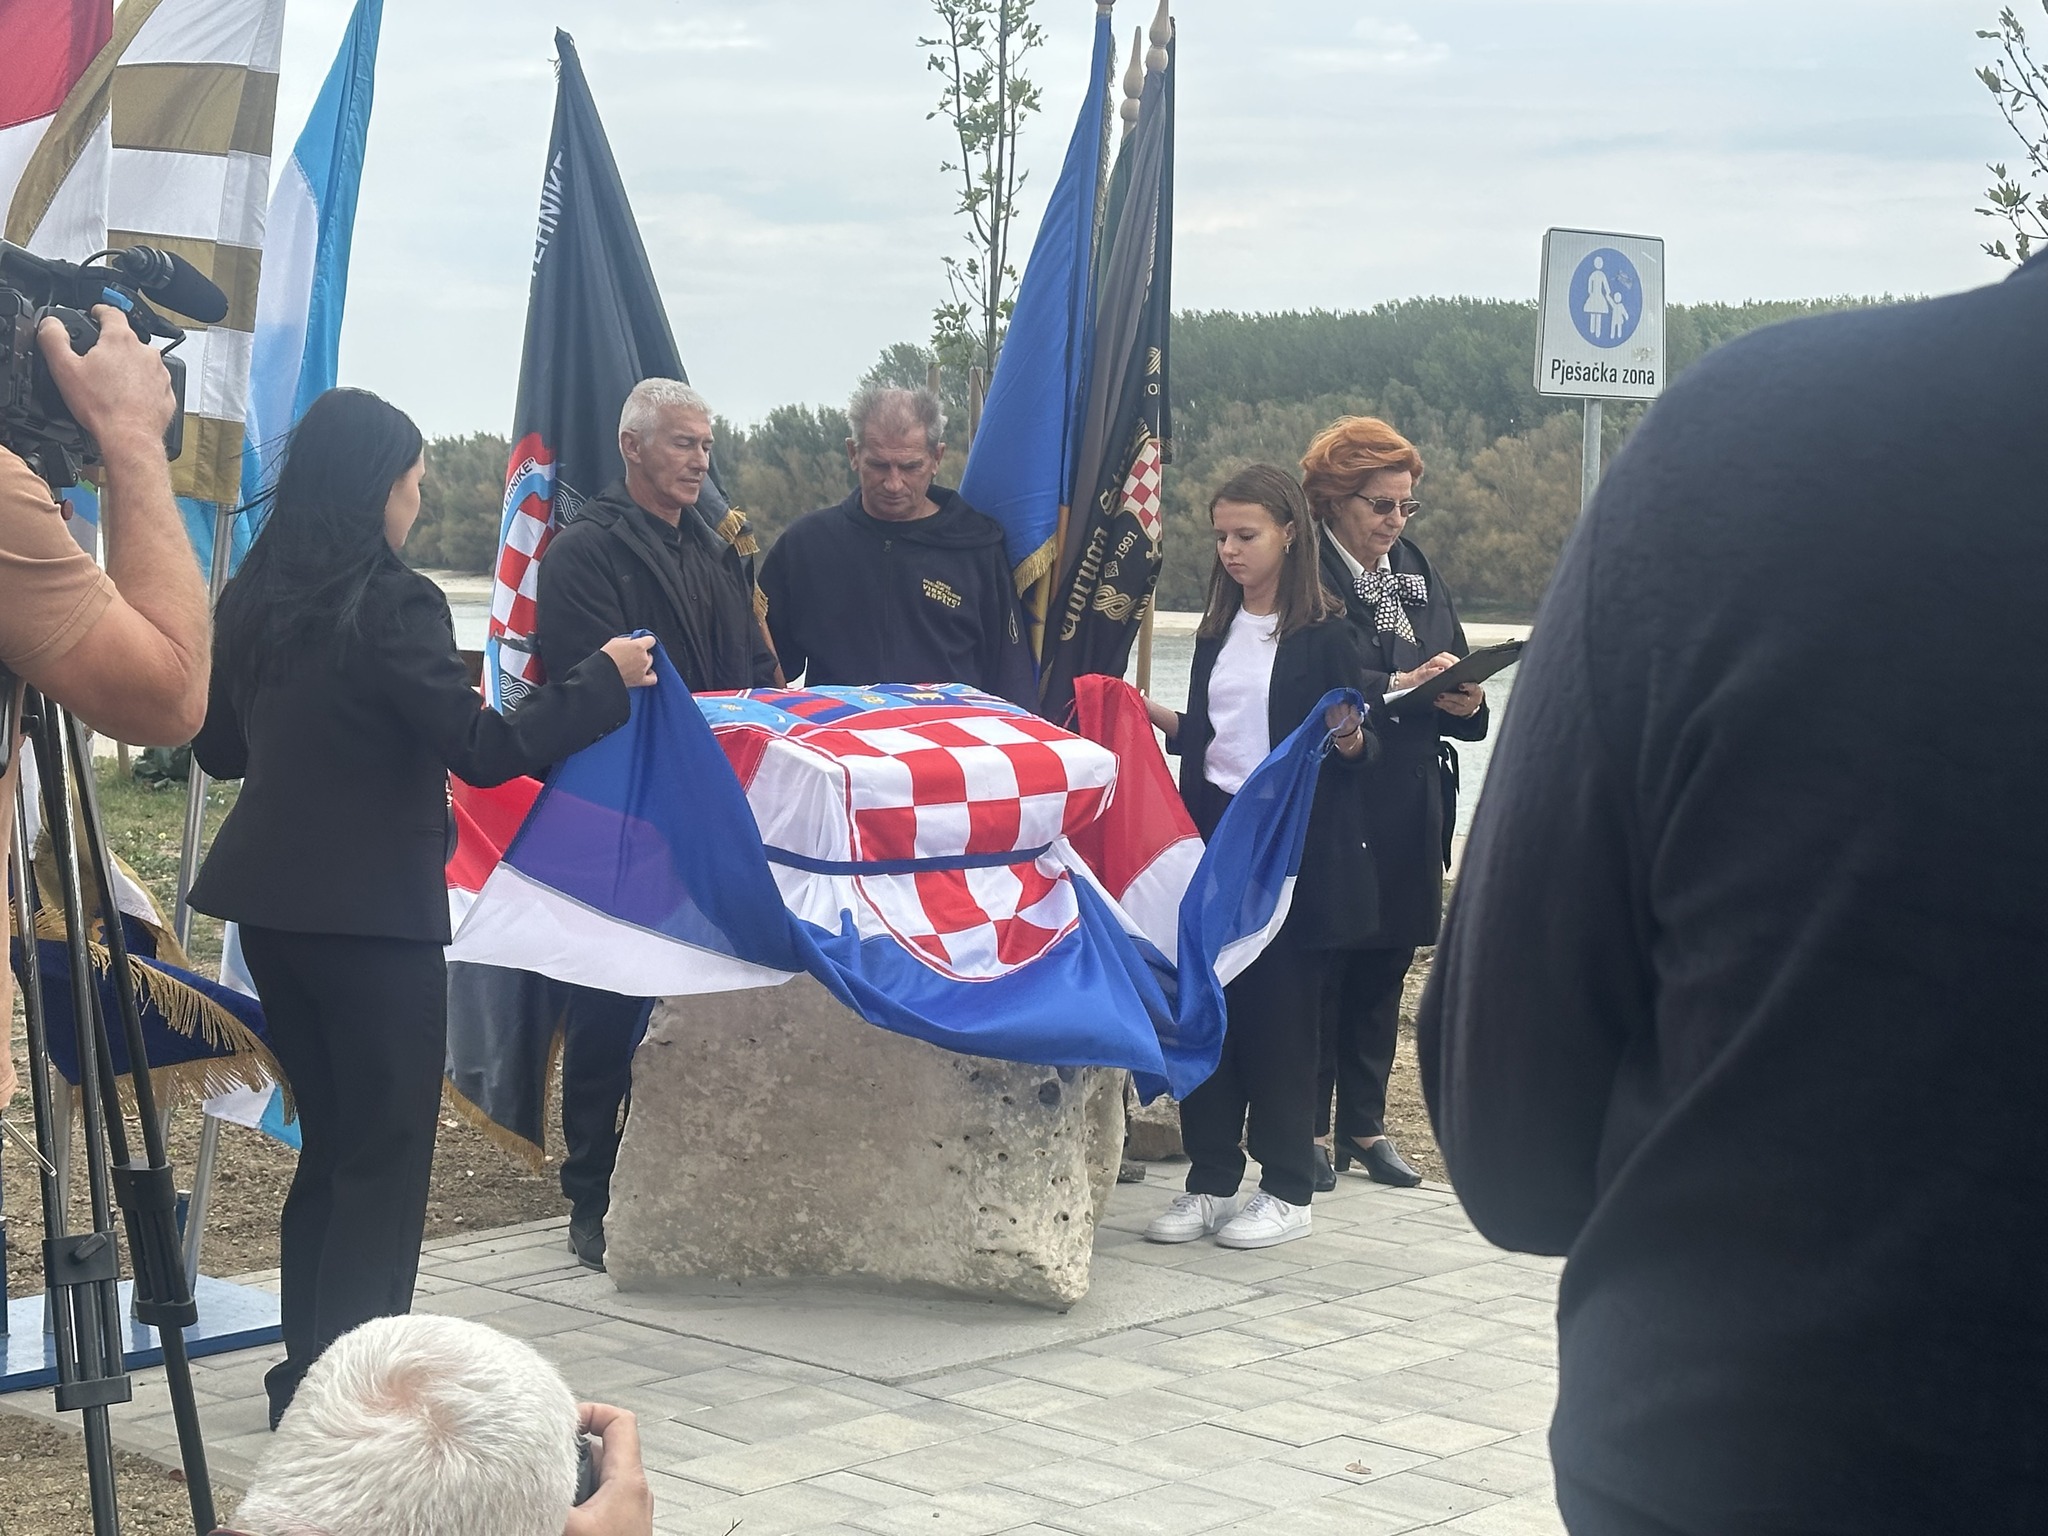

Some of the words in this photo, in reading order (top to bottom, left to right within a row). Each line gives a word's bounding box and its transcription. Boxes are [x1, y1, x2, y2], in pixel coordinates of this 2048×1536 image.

[1551, 358, 1617, 385] Pješačka
[1622, 368, 1655, 385] zona
[1114, 530, 1139, 560] 1991
